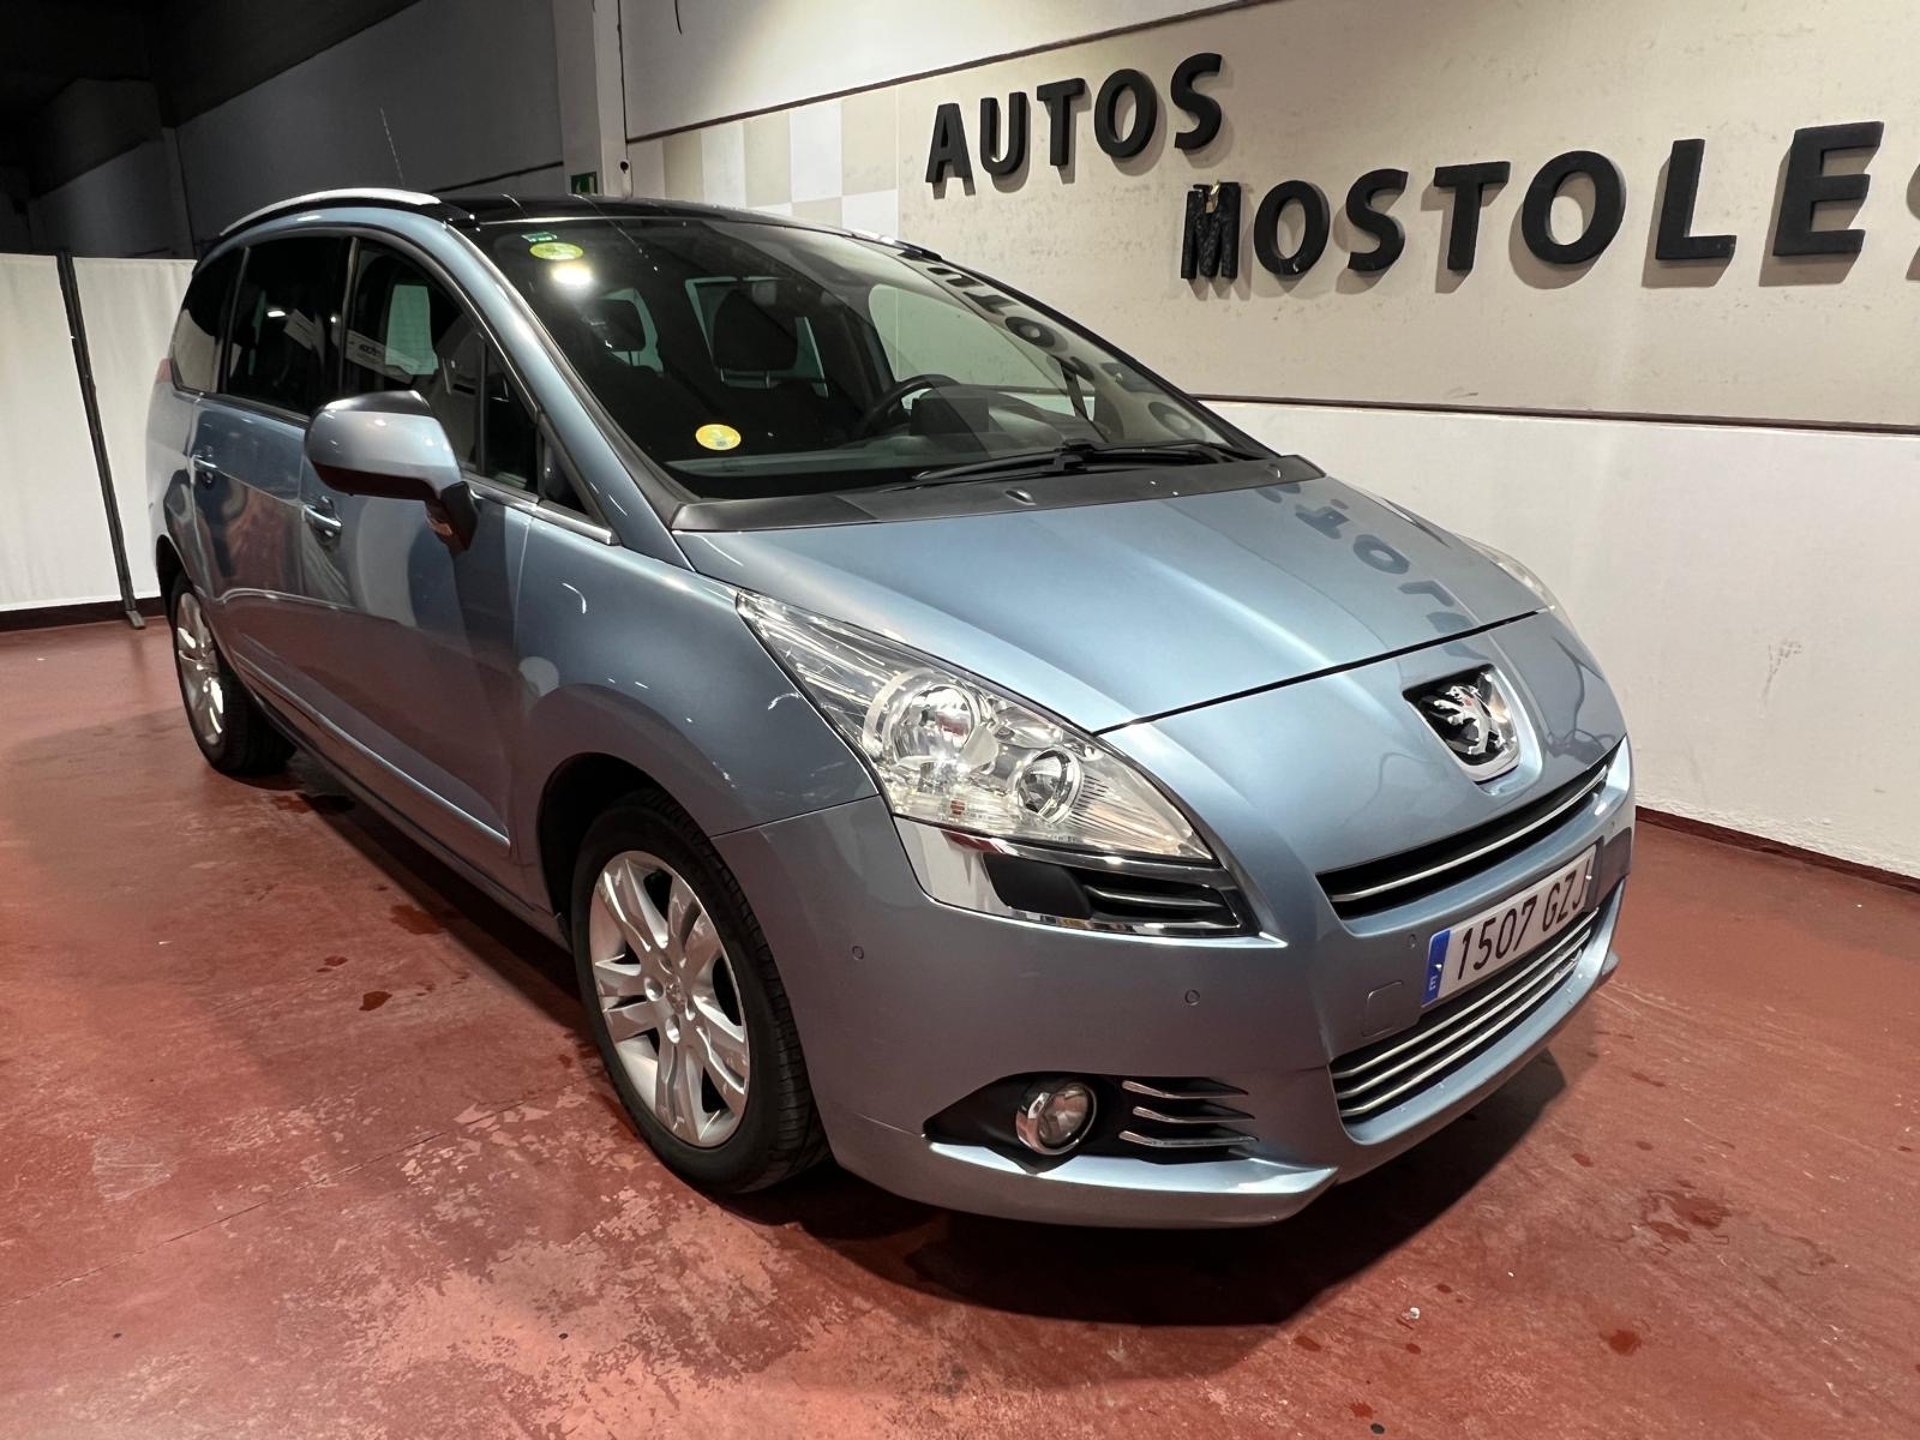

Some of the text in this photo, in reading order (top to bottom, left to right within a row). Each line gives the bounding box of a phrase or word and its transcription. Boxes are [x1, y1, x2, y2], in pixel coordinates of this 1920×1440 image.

[925, 52, 1222, 183] AUTOS
[1180, 122, 1920, 280] MOSTOLE
[1457, 860, 1591, 980] 1507 GZJ
